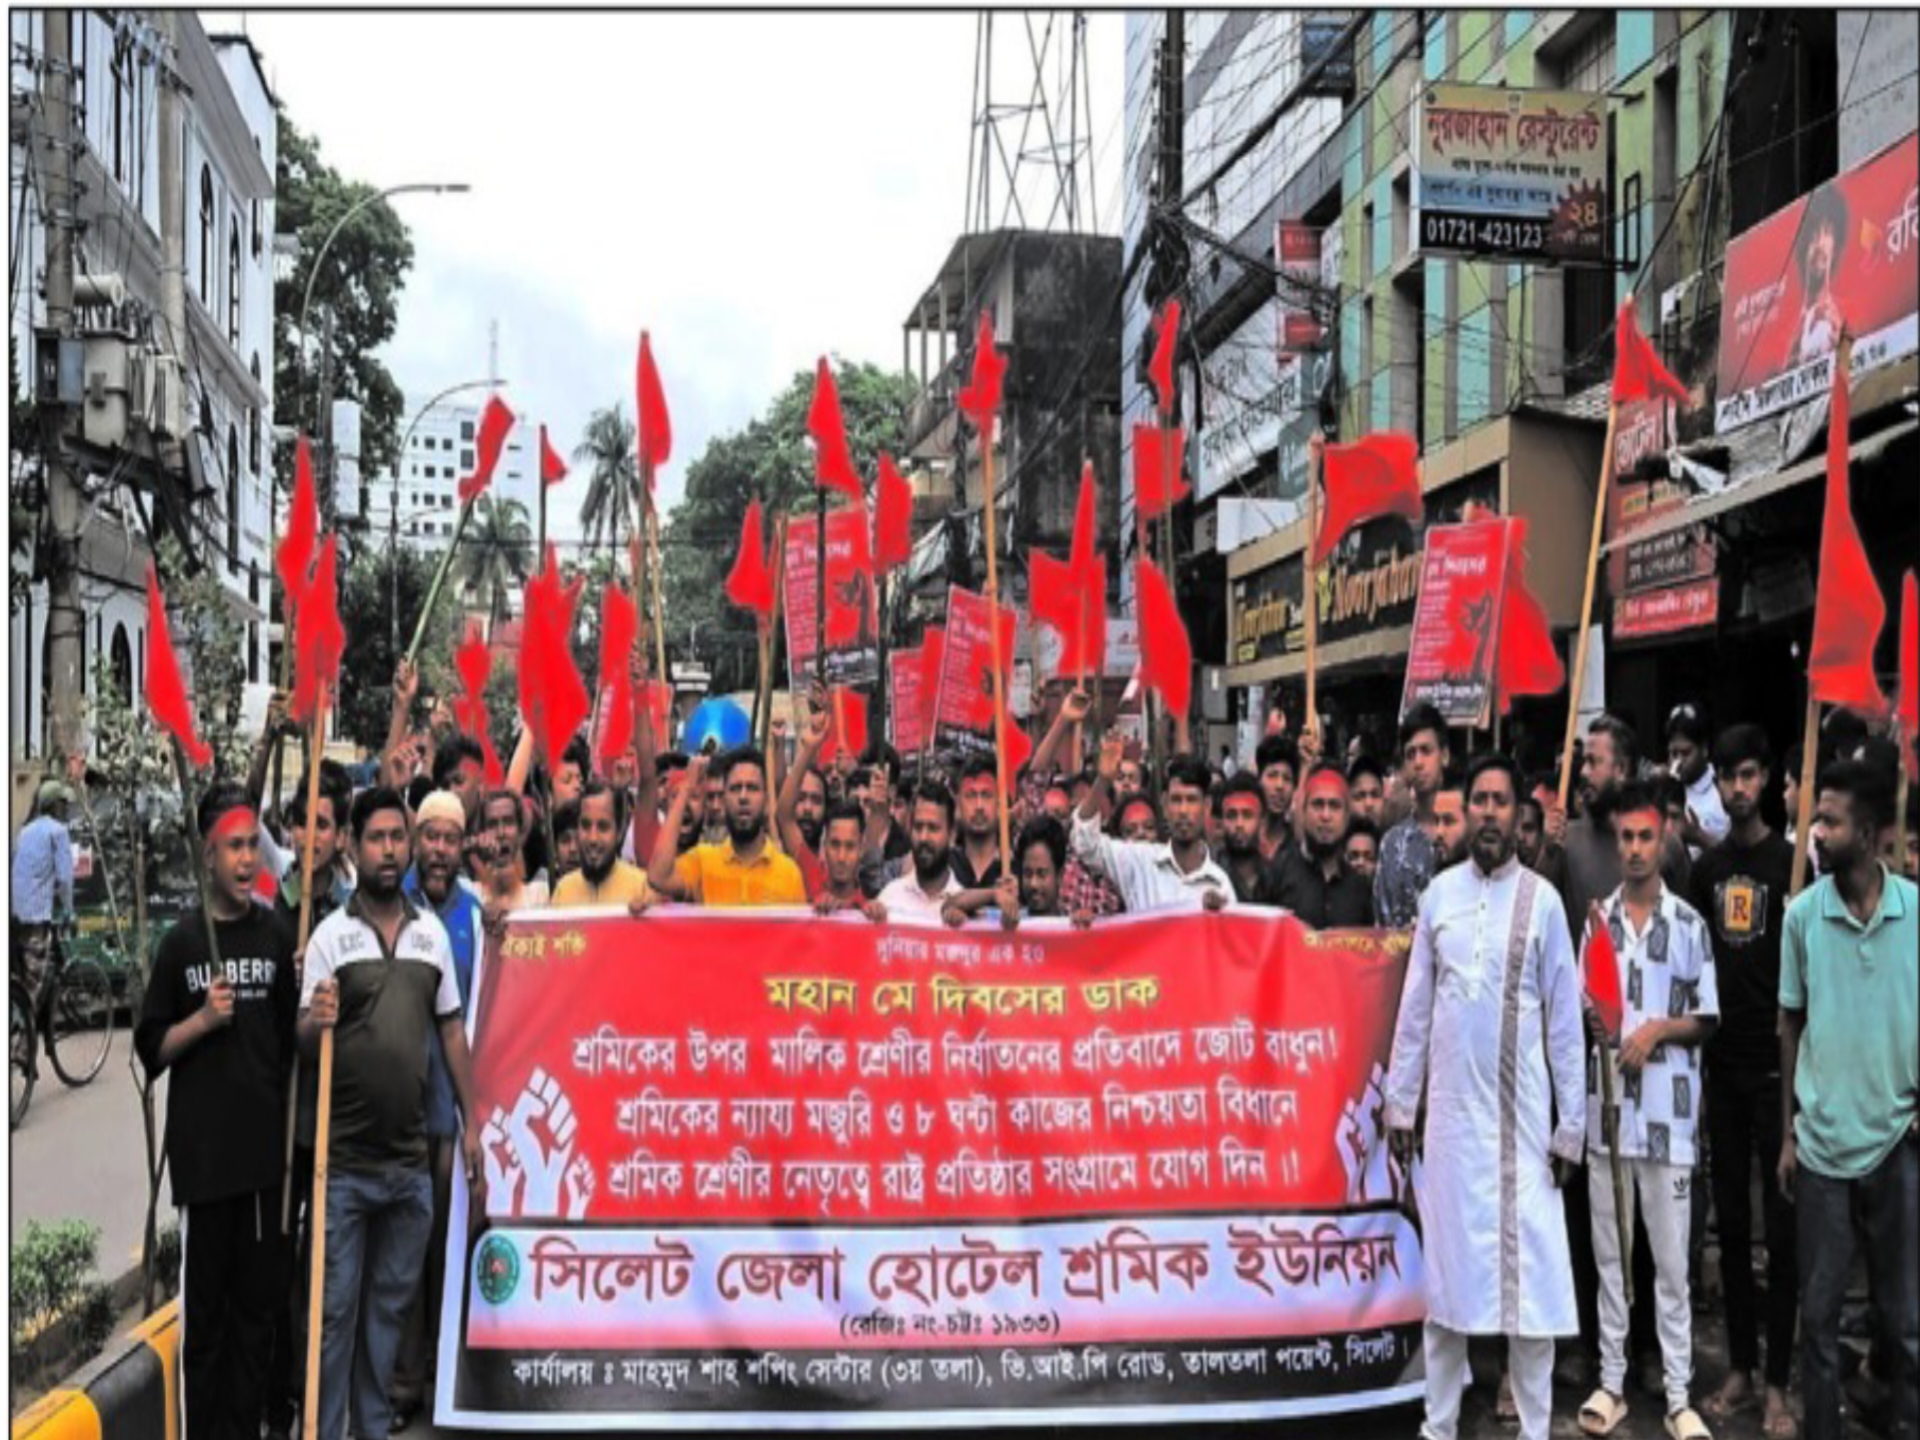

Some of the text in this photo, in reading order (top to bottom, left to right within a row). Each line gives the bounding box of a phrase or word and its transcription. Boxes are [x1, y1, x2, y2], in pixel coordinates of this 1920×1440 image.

[1426, 108, 1509, 155] নূরজাহান
[1426, 217, 1543, 249] 01721-423123
[1568, 202, 1598, 228] ২৪
[1733, 895, 1748, 921] R
[765, 970, 1159, 1015] মহান মে দিবসের ডাক
[573, 1024, 677, 1075] শ্রমিকের
[688, 1028, 747, 1074] উপর
[770, 1027, 847, 1075] মালিক
[858, 1027, 930, 1078] শ্রেণীর
[943, 1028, 1060, 1076] নির্যাতনের
[1072, 1027, 1180, 1074] প্রতিবাদে
[1193, 1017, 1256, 1064] জোট
[616, 1086, 720, 1138] শ্রমিকের
[731, 1098, 795, 1139] ন্যায্য
[805, 1087, 872, 1147] মজুরি
[885, 1102, 905, 1136] ও
[916, 1102, 936, 1136] ৮
[1009, 1096, 1092, 1135] কাজের
[1103, 1081, 1207, 1131] নিশ্চয়তা
[1217, 1075, 1297, 1126] বিধানে
[608, 1146, 684, 1198] শ্রমিক
[694, 1147, 771, 1199] শ্রেণীর
[783, 1159, 871, 1214] নেতৃত্বে
[882, 1152, 926, 1203] রাষ্ট্র
[936, 1146, 1032, 1197] প্রতিষ্ঠার
[1043, 1152, 1137, 1196] সংগ্রামে
[1150, 1147, 1209, 1188] যোগ
[1219, 1135, 1267, 1184] দিন
[529, 1222, 1401, 1306] সিলেট জেলা হোটেল শ্রমিক ইউনিয়ন
[992, 1308, 1061, 1336] ১৯৩৩)
[512, 1350, 592, 1387] কার্যালয়
[622, 1358, 690, 1391] মাহমুদ
[700, 1359, 738, 1387] শাহ
[747, 1347, 798, 1386] শপিং
[805, 1350, 872, 1386] সেন্টার
[881, 1358, 921, 1387] (৩য়
[932, 1356, 993, 1387] তলা),
[1117, 1350, 1175, 1384] রোড,
[1181, 1348, 1267, 1376] তালতলা
[1276, 1343, 1339, 1373] পয়েন্ট,
[1346, 1329, 1395, 1367] সিলেট
